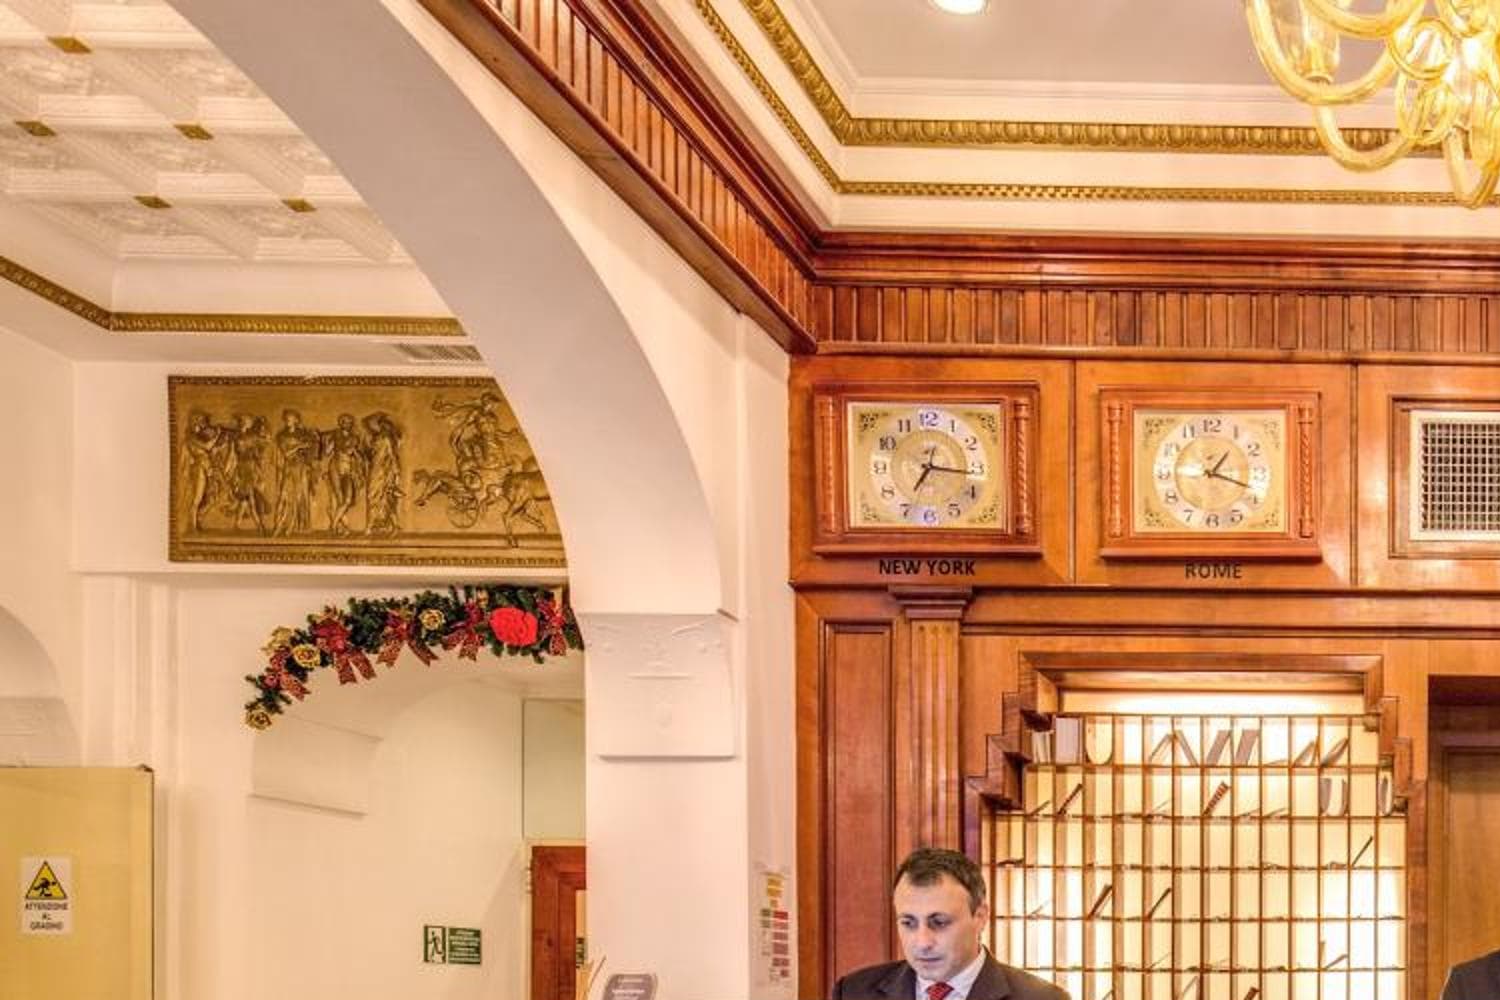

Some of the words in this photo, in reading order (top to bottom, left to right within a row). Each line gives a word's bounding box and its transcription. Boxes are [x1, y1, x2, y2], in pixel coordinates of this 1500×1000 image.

[898, 419, 911, 433] 11
[919, 411, 938, 427] 12
[950, 419, 956, 433] 1
[1202, 419, 1222, 433] 12
[1183, 425, 1195, 439] 11
[1233, 425, 1239, 439] 1
[879, 436, 896, 451] 10
[965, 437, 977, 451] 2
[1247, 443, 1260, 457] 2
[874, 461, 887, 474] 9
[971, 462, 984, 476] 3
[881, 486, 895, 499] 8
[964, 485, 976, 499] 4
[1165, 490, 1178, 504] 8
[900, 503, 912, 517] 7
[923, 509, 937, 523] 6
[948, 503, 961, 517] 5
[1183, 509, 1194, 523] 7
[1230, 509, 1243, 523] 5
[1206, 514, 1219, 528] 6
[879, 559, 920, 575] NEW
[926, 559, 976, 576] YORK
[1185, 563, 1243, 579] ROME
